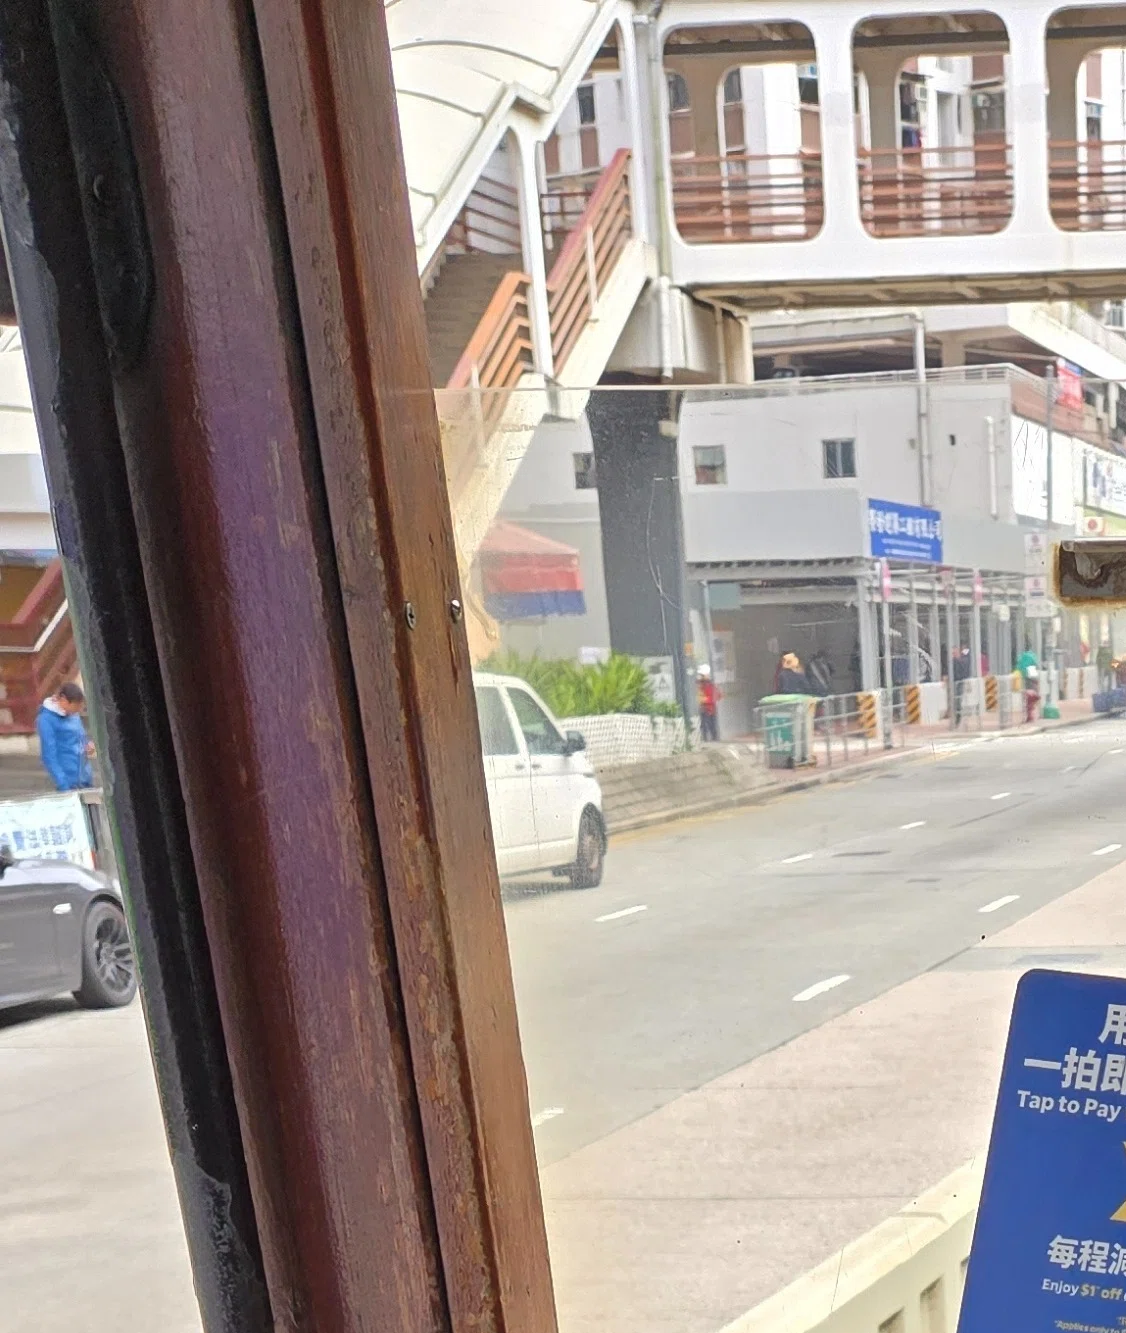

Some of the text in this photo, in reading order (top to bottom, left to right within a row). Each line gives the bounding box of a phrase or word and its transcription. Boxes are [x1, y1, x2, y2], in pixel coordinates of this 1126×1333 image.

[1017, 1090, 1054, 1114] Tap
[1058, 1096, 1080, 1114] to
[1083, 1098, 1122, 1123] Pay
[1041, 1278, 1079, 1297] Enjoy
[1101, 1287, 1123, 1300] off
